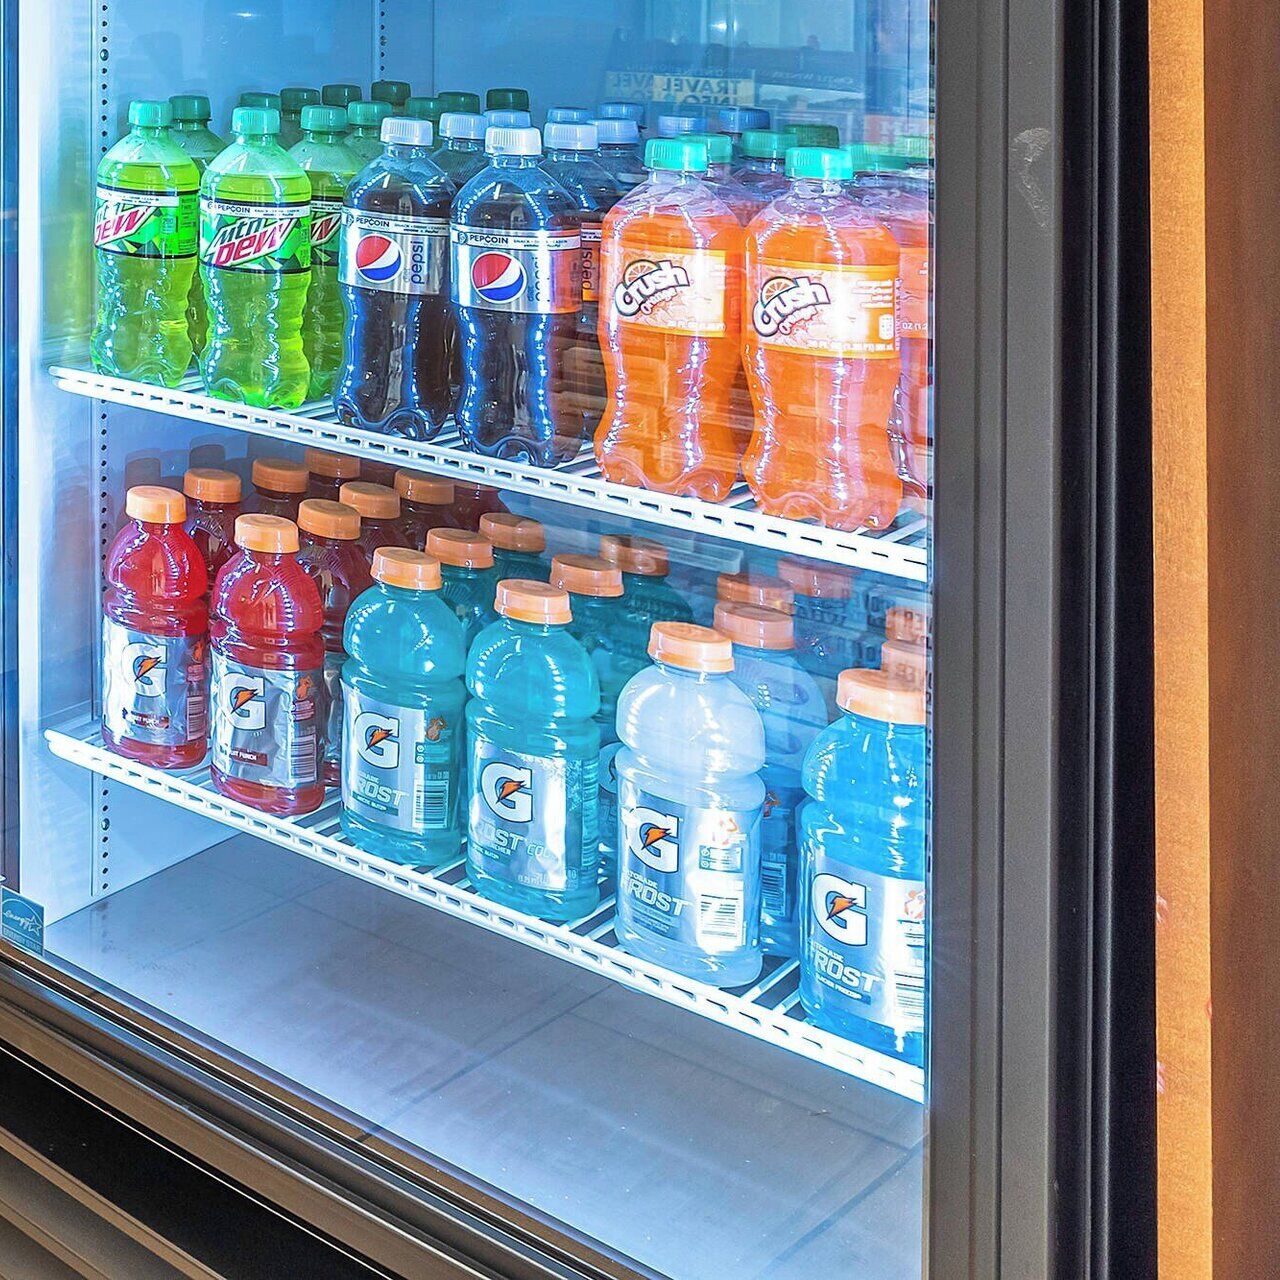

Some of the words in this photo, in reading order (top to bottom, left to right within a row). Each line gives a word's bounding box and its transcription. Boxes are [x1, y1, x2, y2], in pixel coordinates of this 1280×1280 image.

[218, 205, 250, 214] PEPCOIN
[411, 240, 425, 285] pepsi
[470, 234, 508, 245] PEPCOIN
[582, 247, 593, 291] pepsi
[615, 260, 689, 316] Crush
[753, 277, 830, 336] Crush
[122, 643, 168, 697] G
[220, 672, 266, 731] G
[354, 711, 400, 770] G
[481, 762, 533, 823] G
[626, 806, 679, 873] G
[812, 873, 868, 947] G
